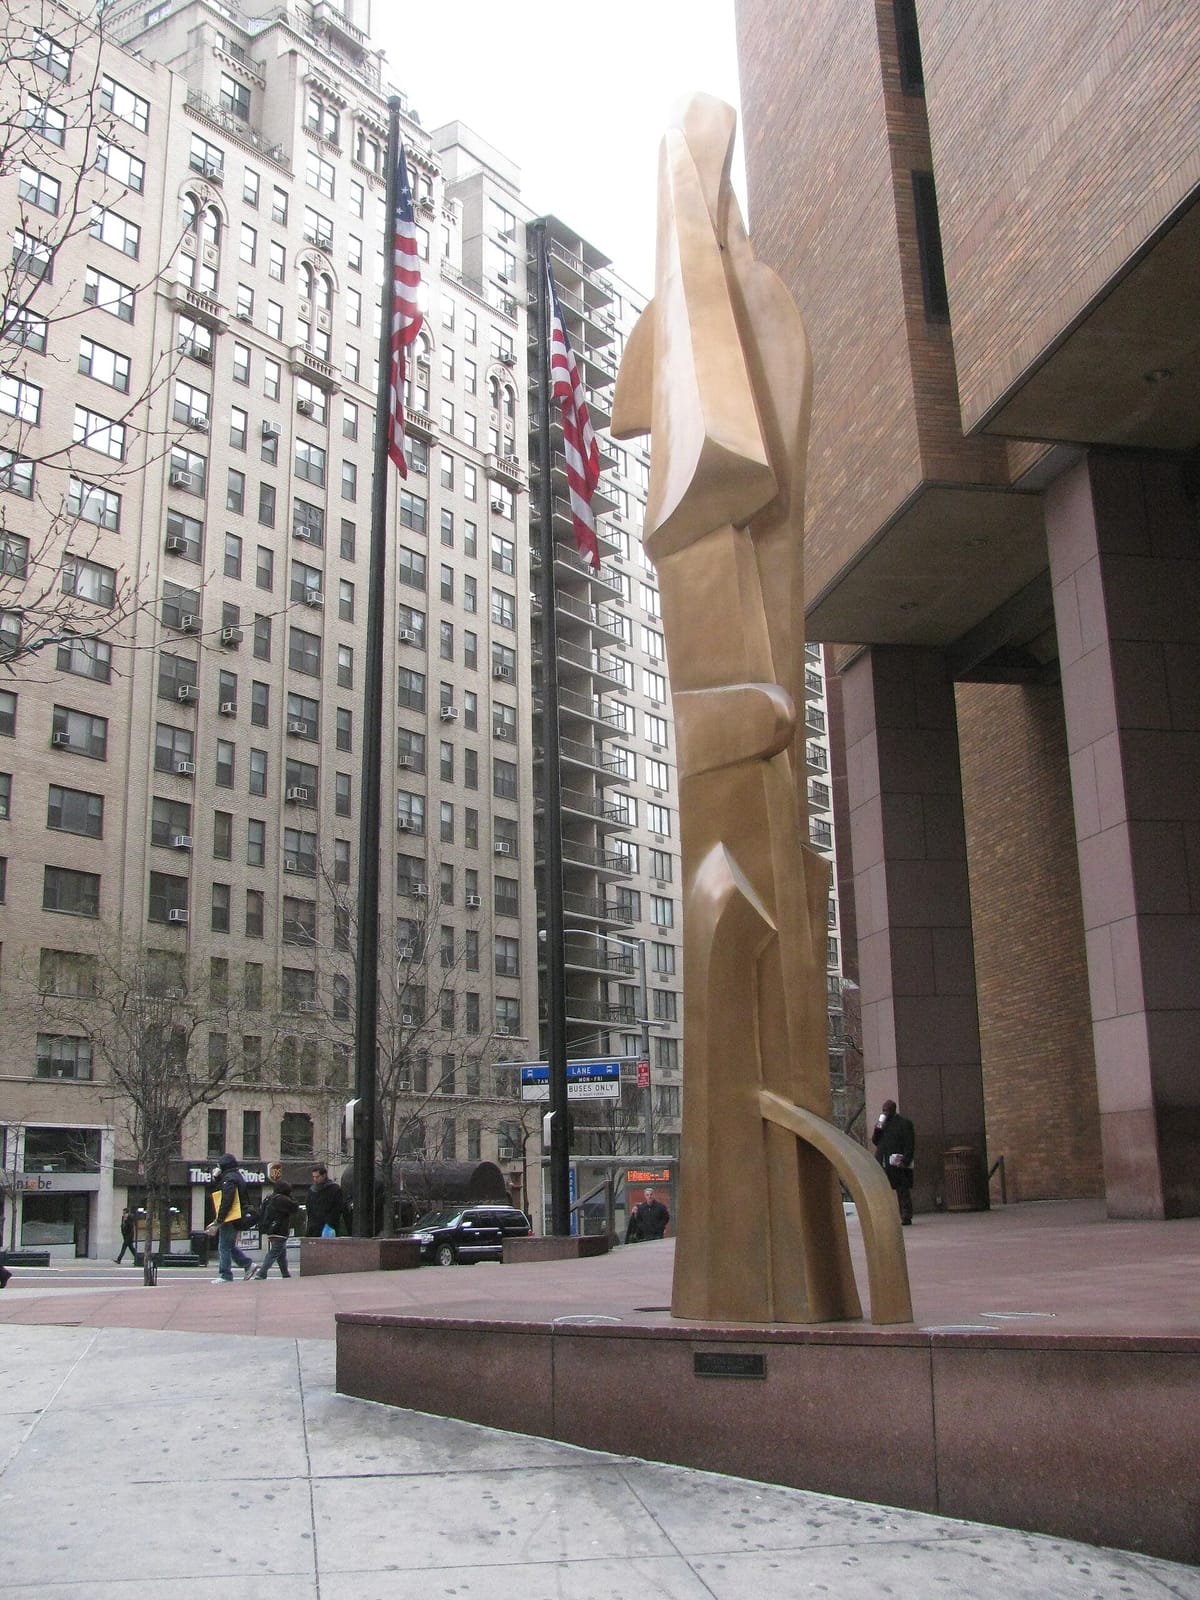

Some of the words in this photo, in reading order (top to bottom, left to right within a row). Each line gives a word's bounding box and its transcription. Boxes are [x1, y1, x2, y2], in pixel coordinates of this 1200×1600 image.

[572, 1066, 591, 1076] LANE
[568, 1085, 592, 1093] BUSES
[595, 1084, 614, 1092] ONLY
[190, 1169, 211, 1182] The
